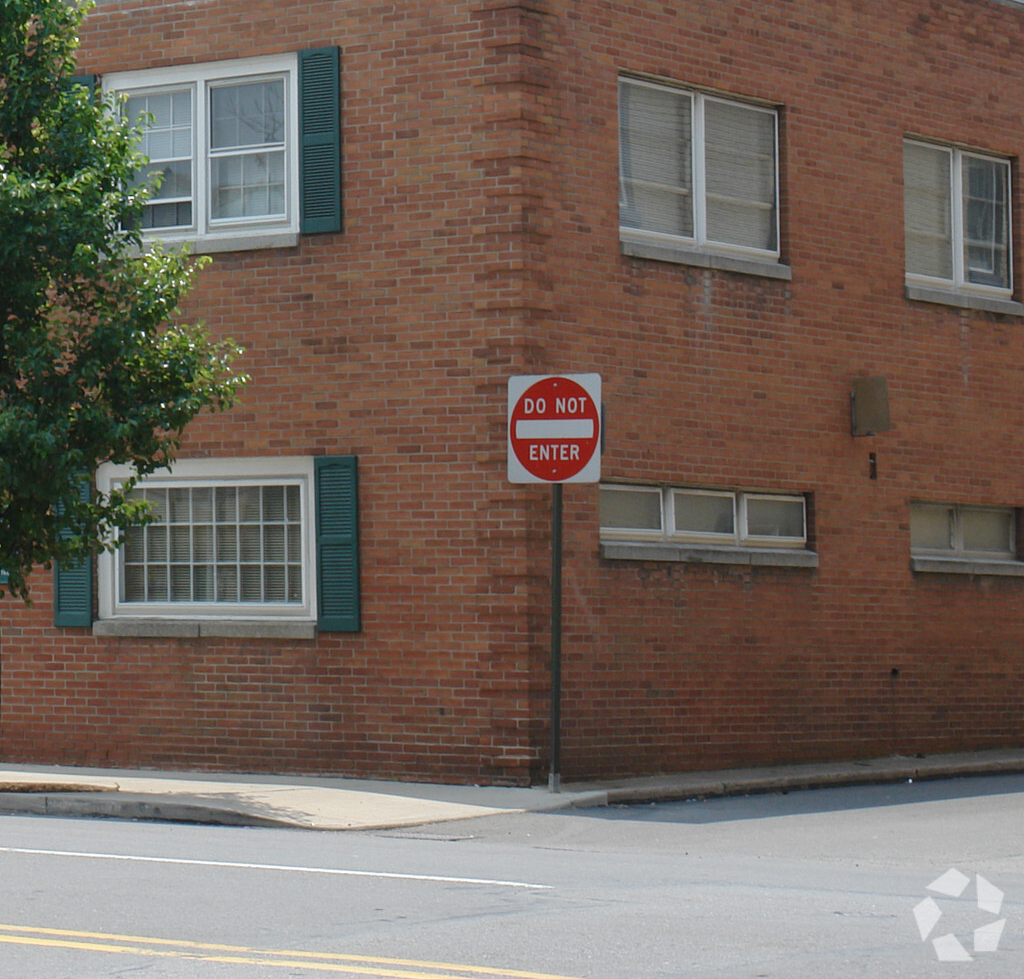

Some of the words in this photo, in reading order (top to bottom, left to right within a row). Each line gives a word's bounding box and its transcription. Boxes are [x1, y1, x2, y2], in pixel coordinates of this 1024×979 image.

[523, 397, 547, 414] DO
[555, 396, 587, 414] NOT
[528, 444, 580, 461] ENTER
